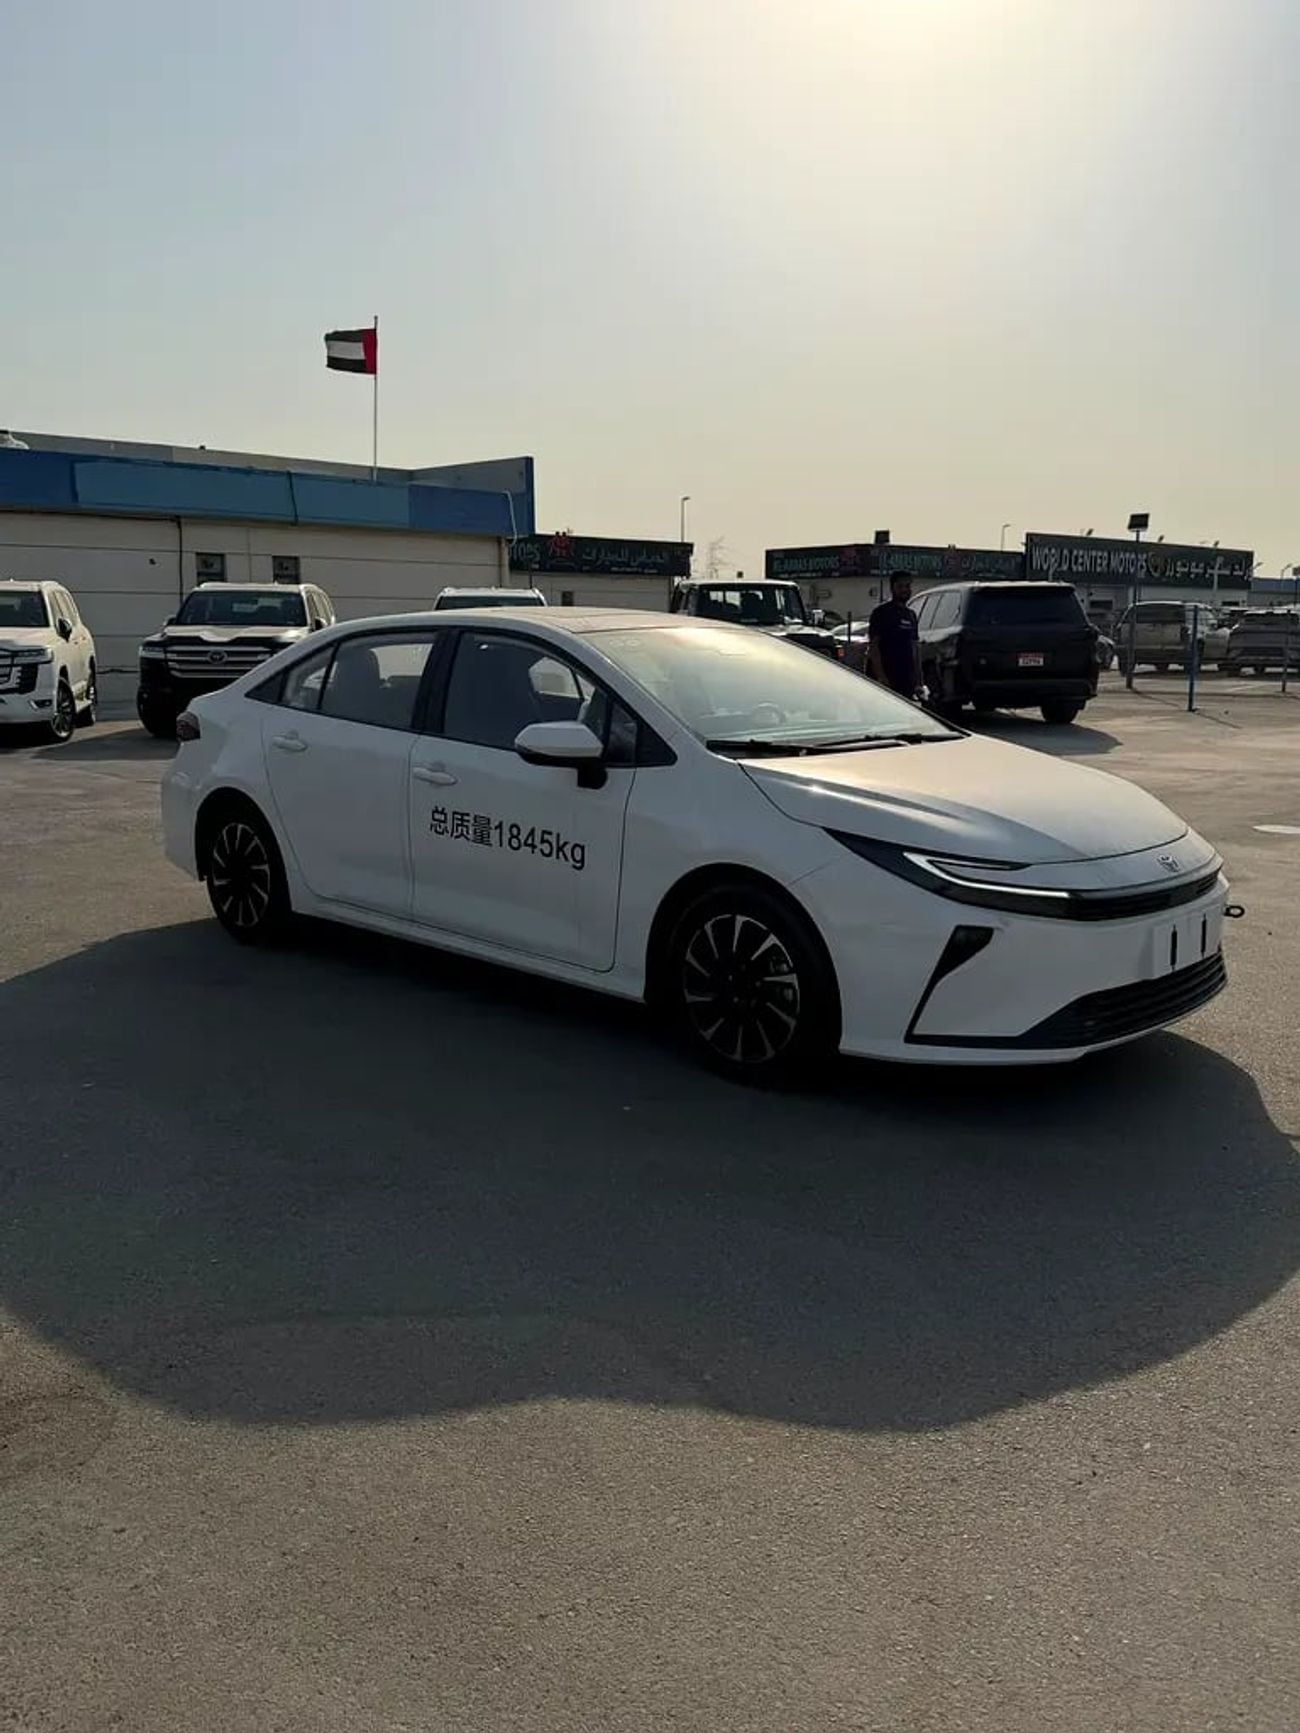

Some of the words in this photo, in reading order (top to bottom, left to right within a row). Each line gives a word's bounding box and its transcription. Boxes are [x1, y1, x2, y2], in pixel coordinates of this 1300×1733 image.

[1032, 546, 1070, 571] WORLD
[1071, 548, 1108, 572] CENTER
[1109, 550, 1147, 575] MOTORS
[430, 806, 586, 870] 总质量1845kg
